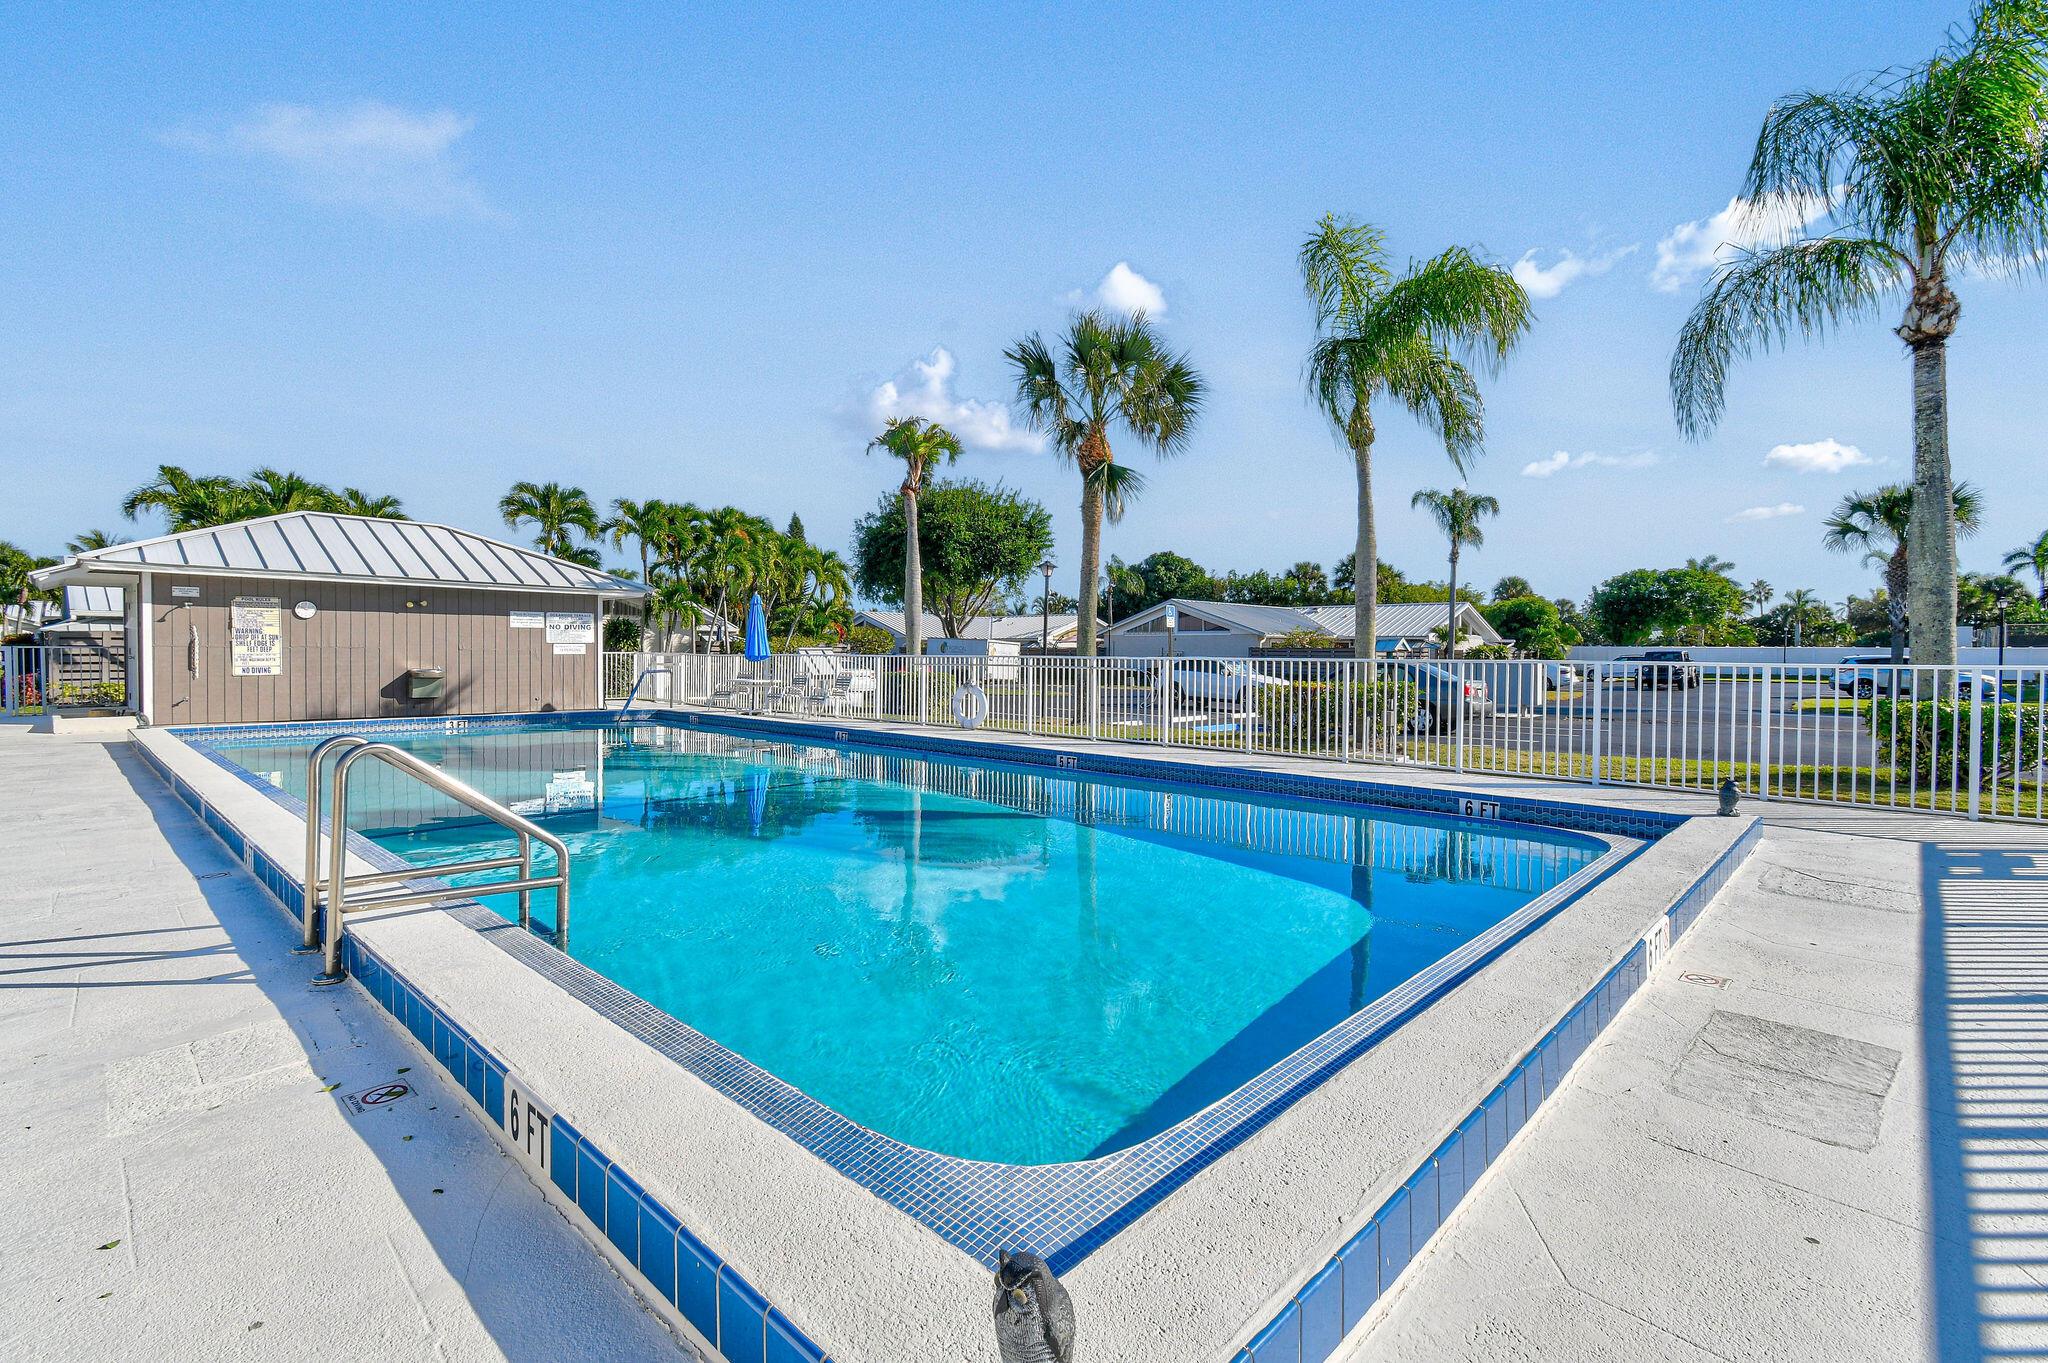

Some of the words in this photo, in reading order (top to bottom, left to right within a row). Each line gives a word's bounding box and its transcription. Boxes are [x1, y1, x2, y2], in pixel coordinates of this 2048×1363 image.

[449, 721, 455, 729] 3
[457, 720, 468, 729] FT
[1066, 757, 1077, 769] FT
[1465, 800, 1474, 816] 6
[1480, 801, 1499, 819] FT
[1648, 938, 1653, 972] 6
[1654, 928, 1663, 965] FT
[511, 1089, 519, 1141] 6
[527, 1102, 548, 1169] FT
